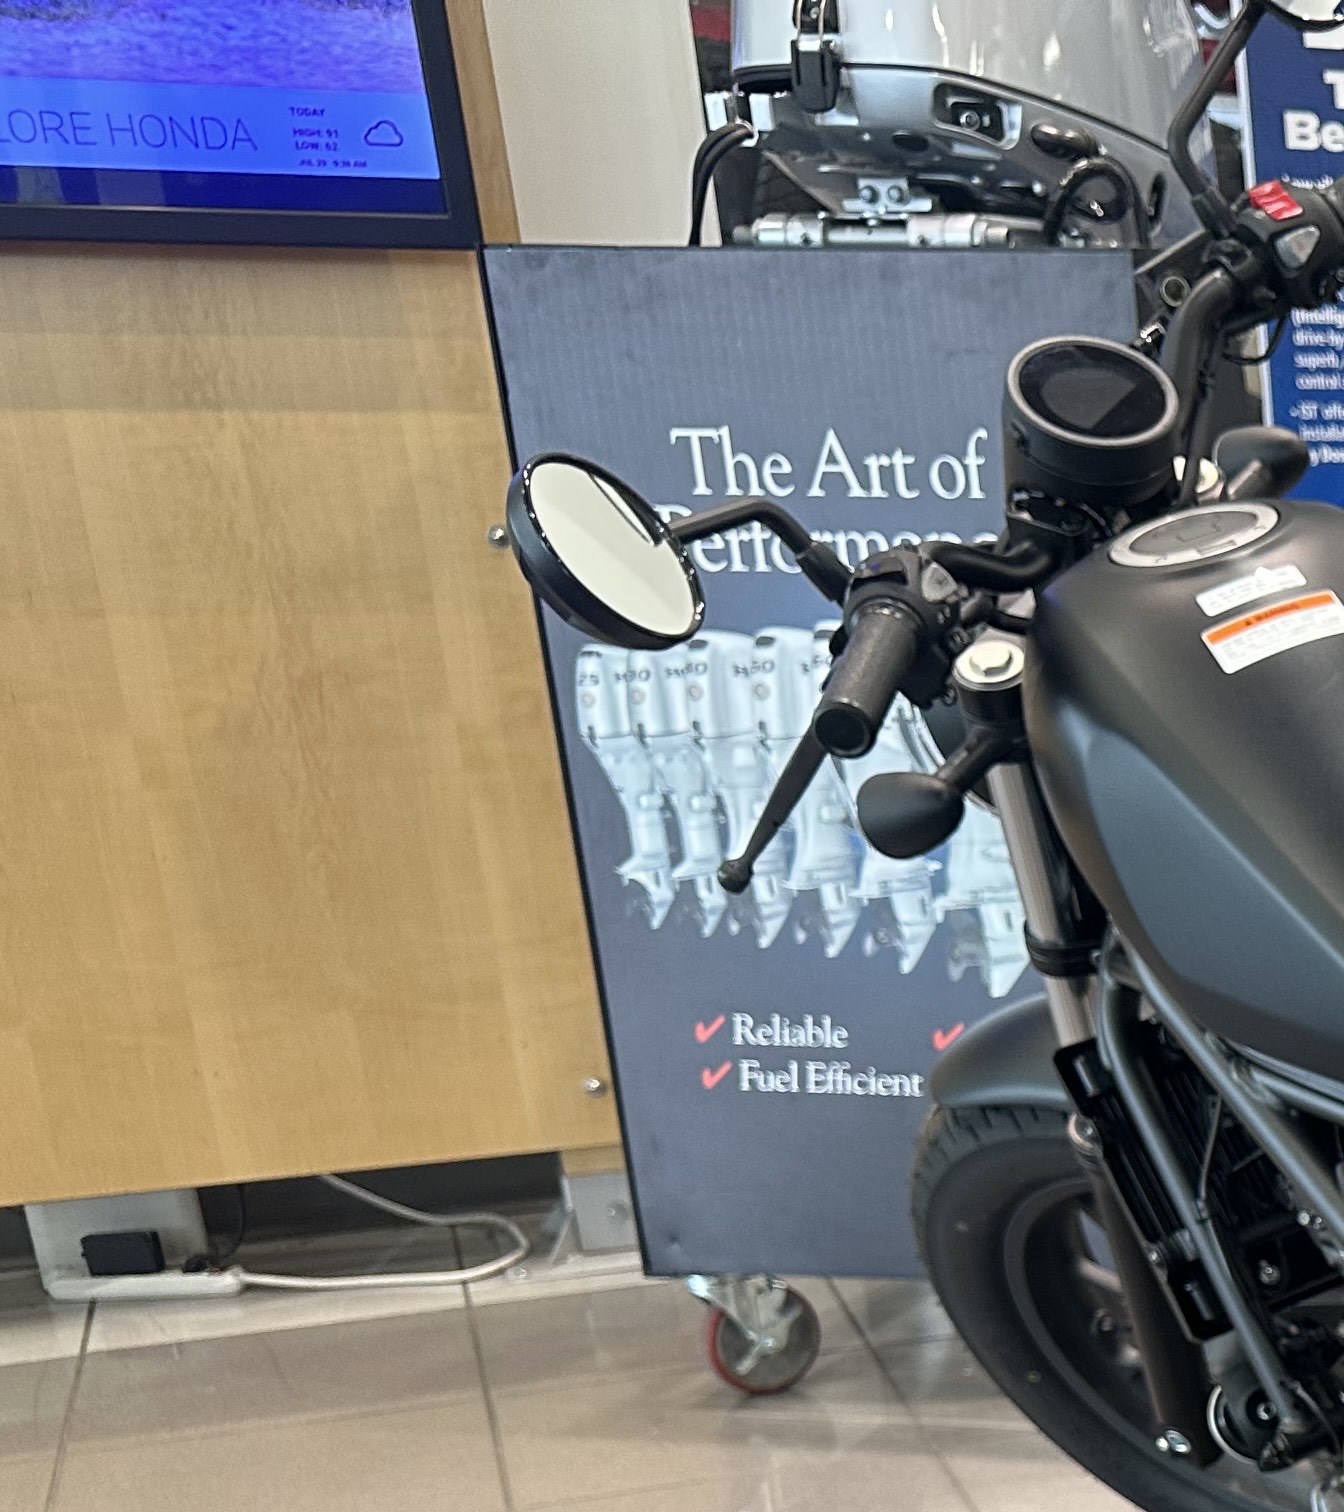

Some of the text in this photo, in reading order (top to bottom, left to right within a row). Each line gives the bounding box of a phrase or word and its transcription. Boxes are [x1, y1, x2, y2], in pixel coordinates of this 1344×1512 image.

[289, 107, 325, 117] TODAY
[106, 113, 258, 151] HONDA
[670, 424, 988, 499] The Art of
[732, 1012, 849, 1049] Reliable
[739, 1059, 924, 1098] Fuel Efficient
